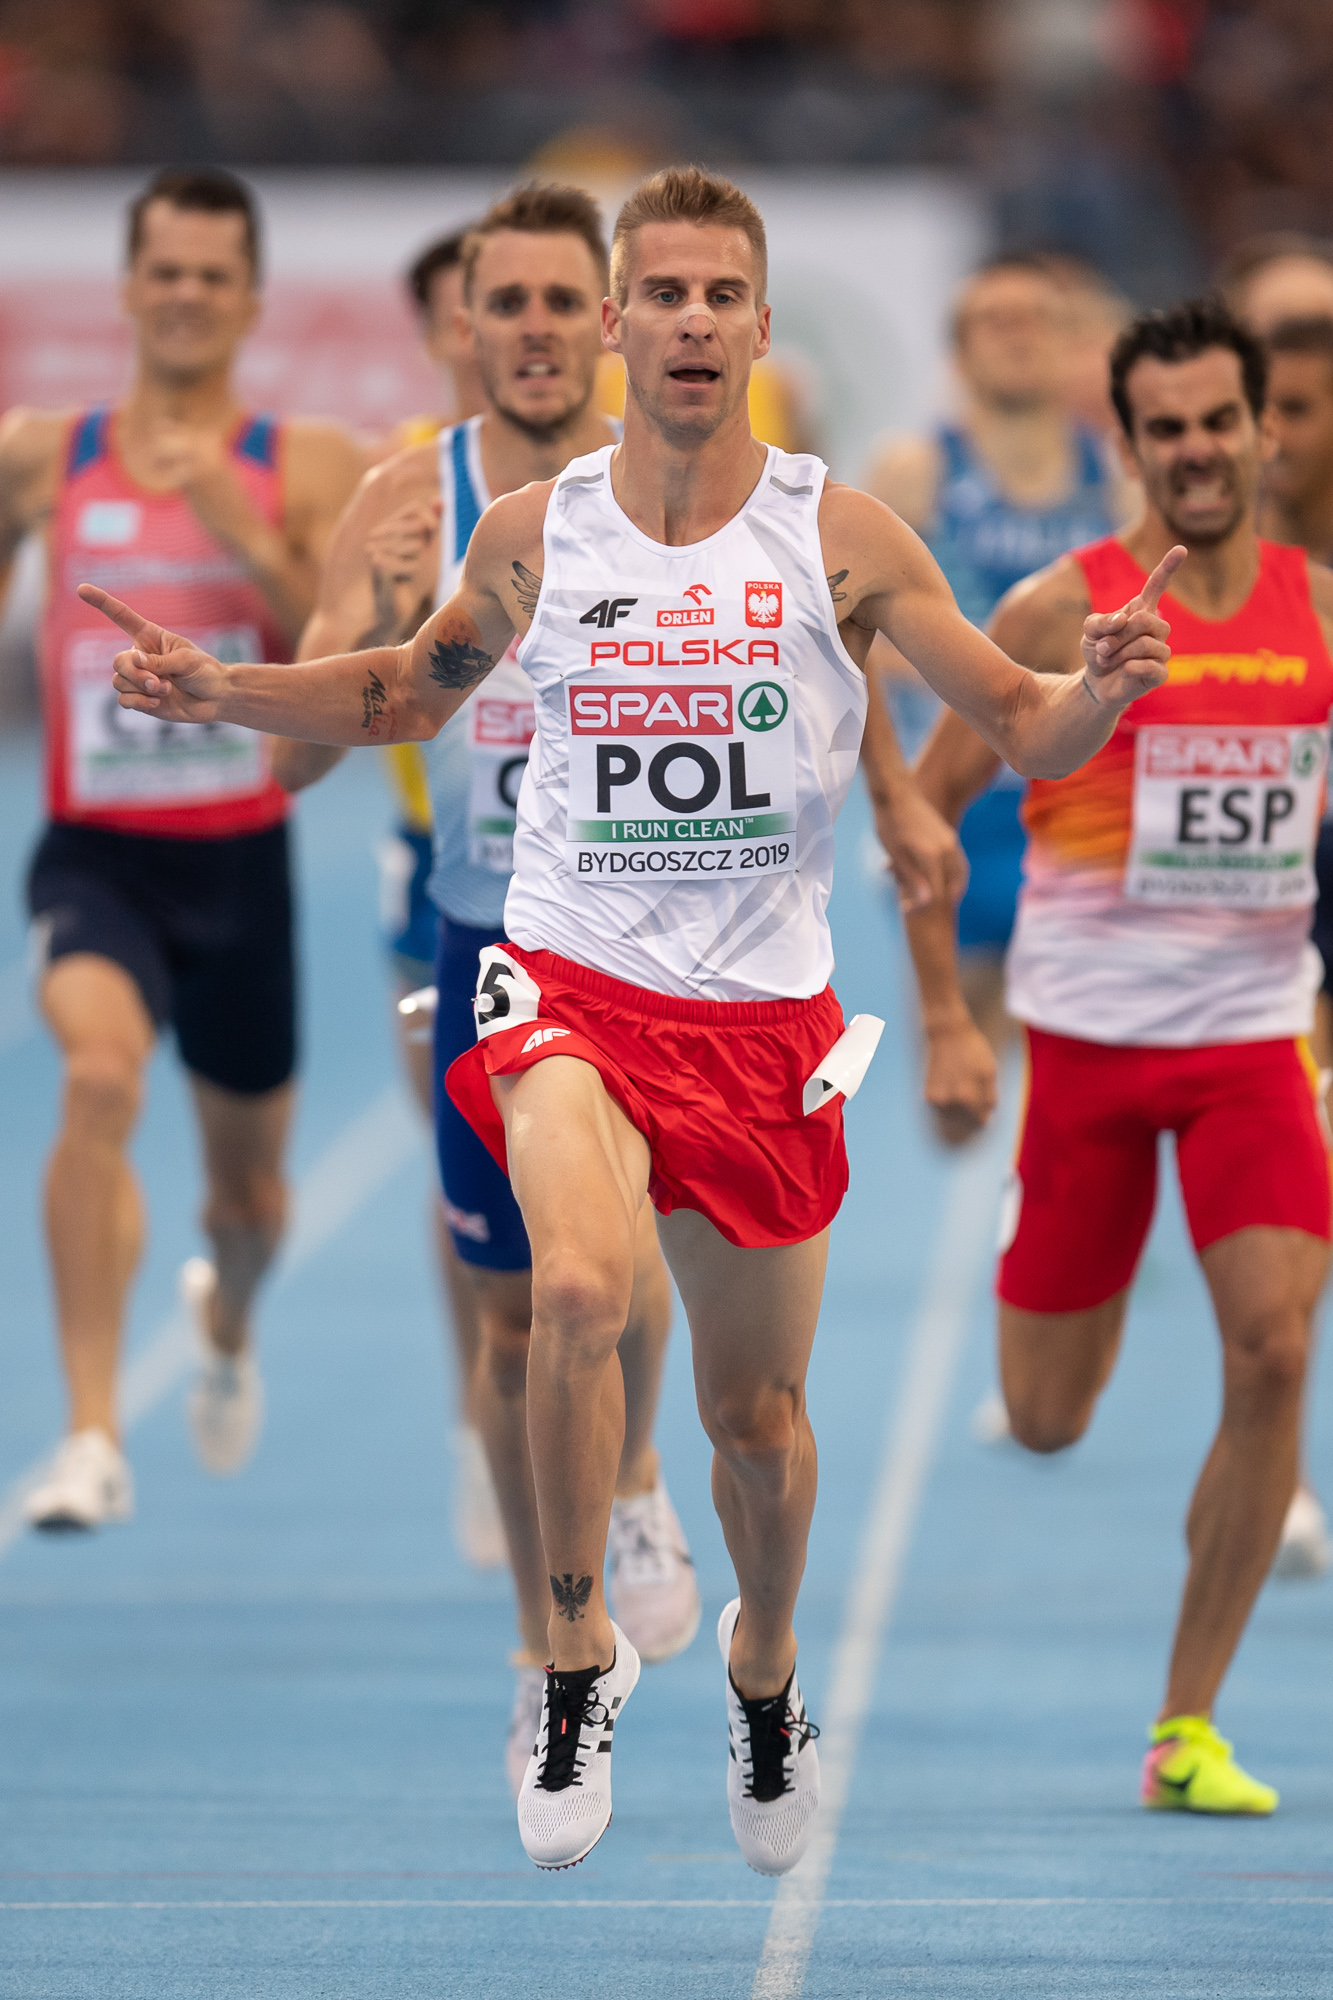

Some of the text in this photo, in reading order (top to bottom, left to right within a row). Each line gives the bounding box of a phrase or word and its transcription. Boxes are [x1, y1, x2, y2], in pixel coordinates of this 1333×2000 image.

[747, 582, 780, 590] POLSKA
[579, 598, 639, 629] 4F
[659, 610, 711, 626] ORLEN
[590, 639, 779, 667] POLSKA
[573, 692, 729, 728] SPAR
[1149, 736, 1285, 775] SPAR
[596, 742, 771, 814] POL
[612, 823, 617, 839] I
[623, 822, 669, 839] RUN
[1177, 786, 1295, 845] ESP
[577, 842, 790, 873] BYDGOSZCZ 2019
[478, 961, 516, 1025] 5
